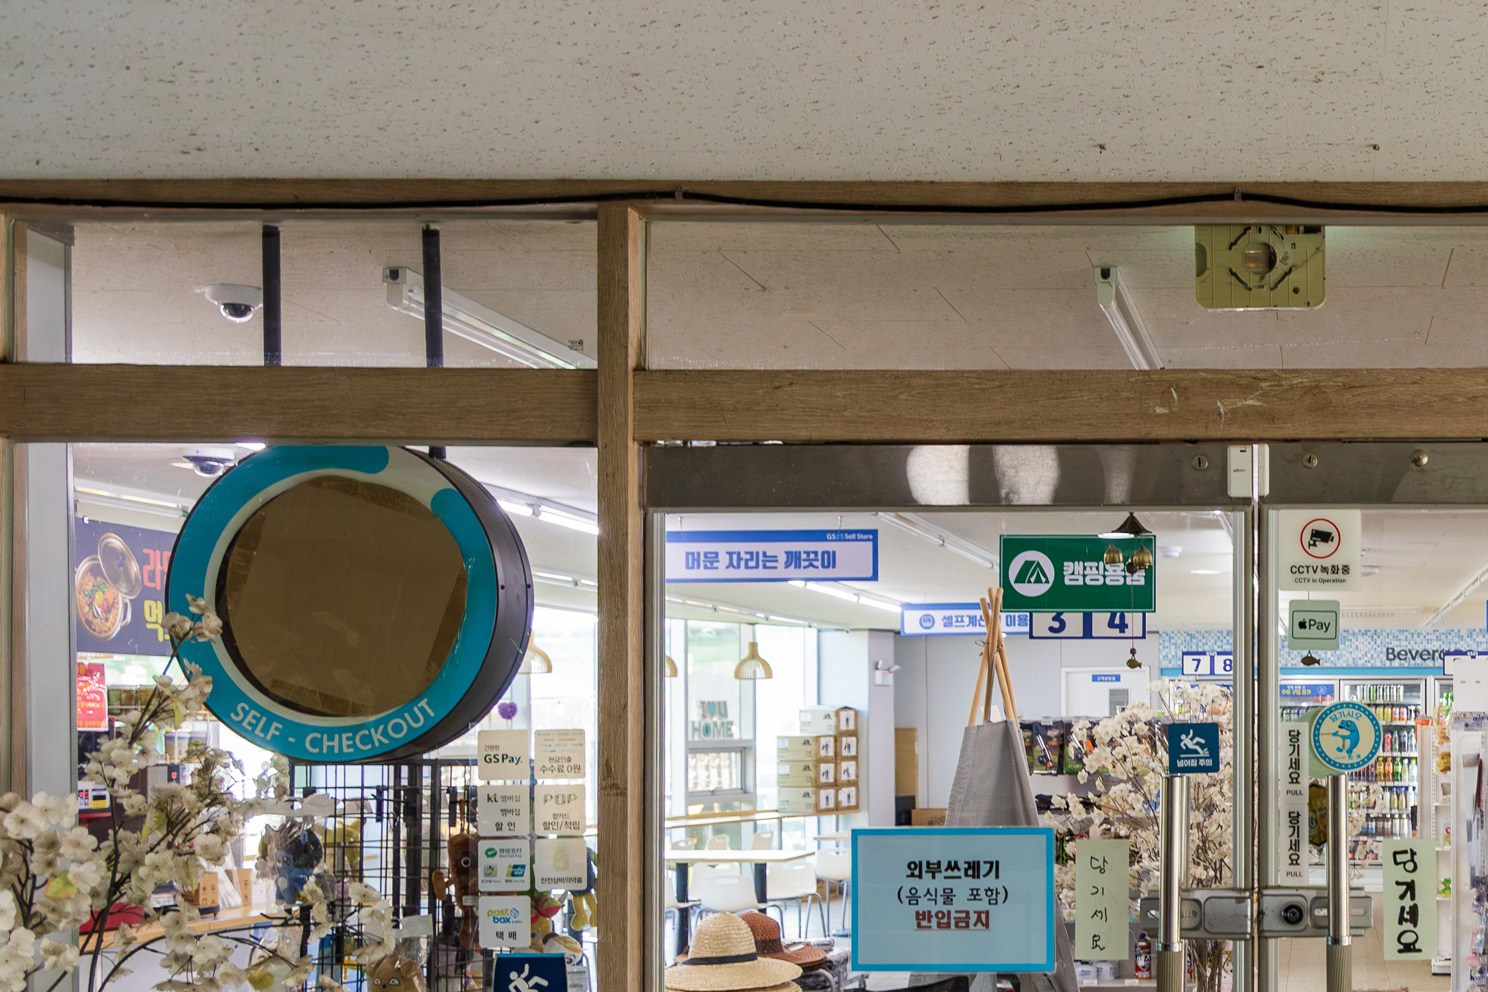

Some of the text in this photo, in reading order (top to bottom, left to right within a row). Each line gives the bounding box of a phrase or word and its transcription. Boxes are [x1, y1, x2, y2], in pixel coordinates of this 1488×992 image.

[142, 548, 171, 591] 라
[685, 549, 837, 570] 머문 자리는 깨끗이
[1290, 564, 1319, 575] CCTV
[1062, 560, 1147, 586] 캠핑용품
[1318, 577, 1347, 585] Operation
[143, 599, 171, 642] 먹
[942, 613, 1002, 628] 셀프계
[1048, 611, 1067, 634] 3
[1107, 611, 1129, 634] 4
[1308, 619, 1331, 633] Pay
[1386, 646, 1468, 661] Bever
[1191, 658, 1202, 672] 7
[1222, 658, 1233, 672] 8
[230, 702, 284, 743] SELF
[304, 697, 436, 754] CHECKOUT
[1329, 710, 1363, 723] 당기시오
[691, 720, 734, 740] HOME
[1176, 758, 1213, 768] 넘어짐 주의
[1288, 729, 1301, 786] 당기세요
[540, 764, 581, 774] 수수료 0원
[486, 793, 498, 803] kt
[1288, 810, 1301, 866] 당기세요
[905, 859, 1000, 880] 외부쓰레기
[896, 885, 1009, 906] (음식물 포함)
[1089, 855, 1109, 952] 당기세요
[1392, 847, 1423, 954] 당기세요
[486, 908, 510, 918] post
[492, 915, 511, 924] box
[914, 909, 991, 931] 반입금지
